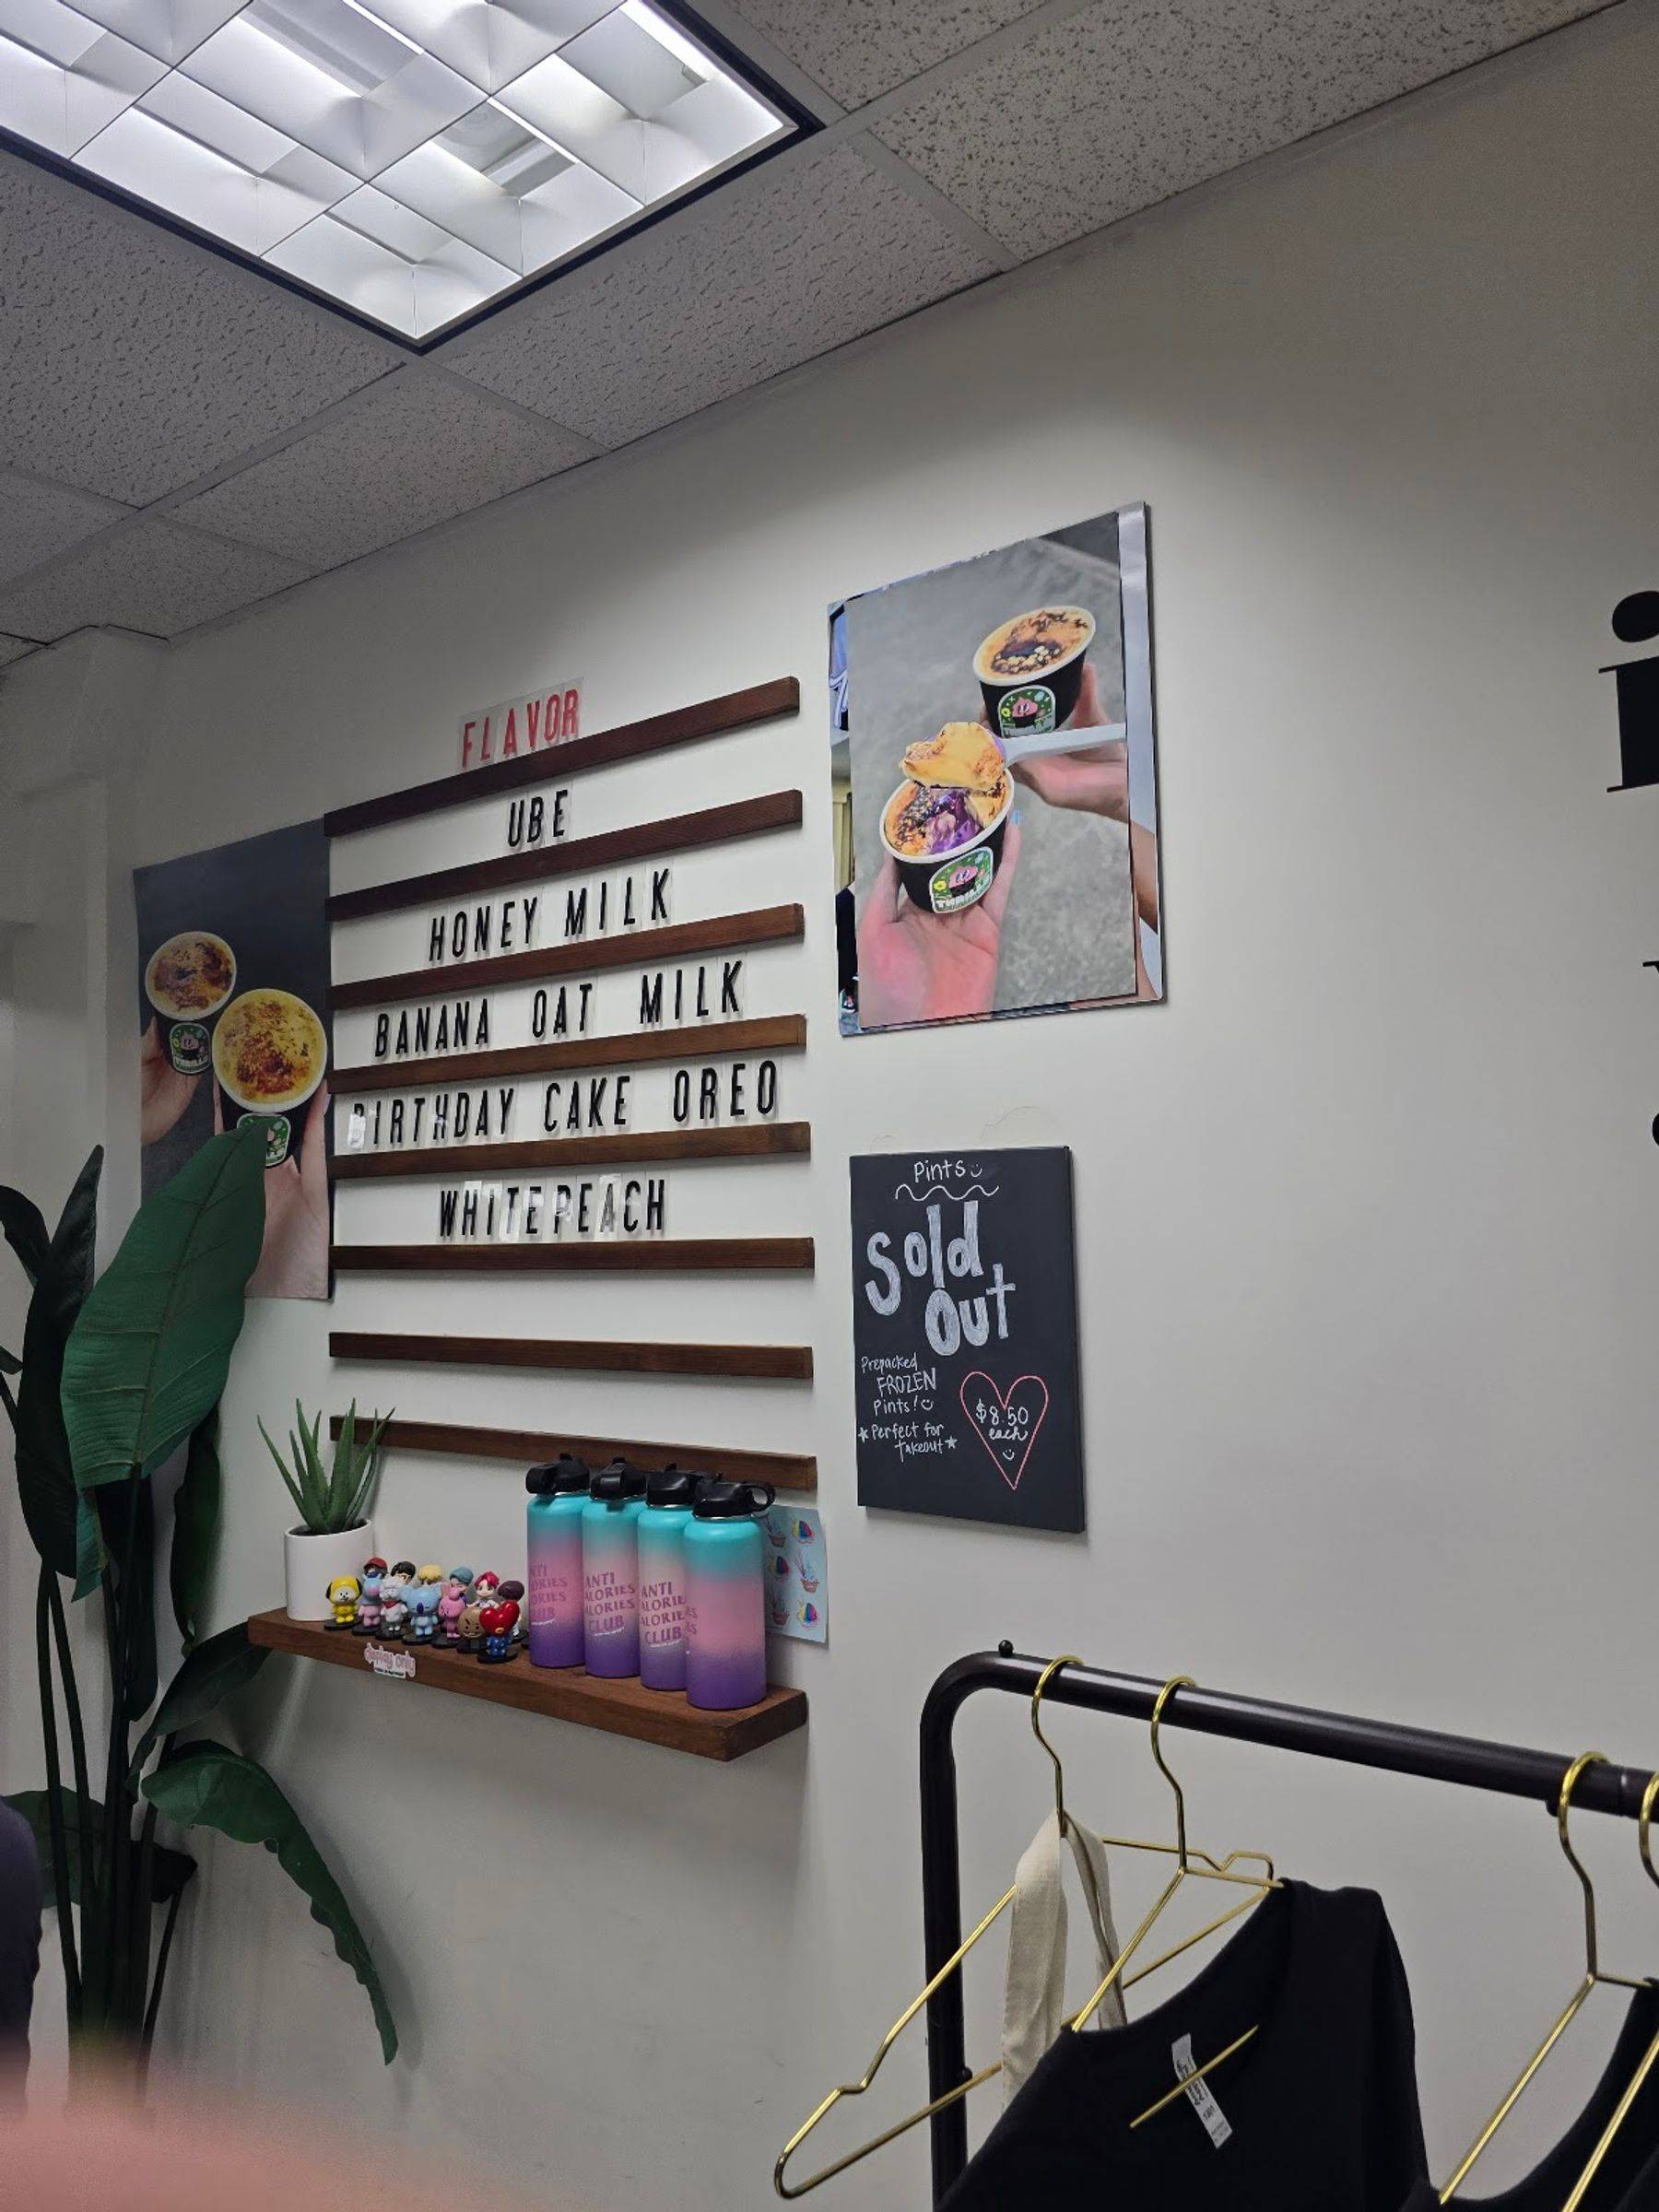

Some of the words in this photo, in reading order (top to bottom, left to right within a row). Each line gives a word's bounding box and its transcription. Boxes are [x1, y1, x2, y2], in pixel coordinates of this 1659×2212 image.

[463, 688, 580, 768] FLAVOR
[508, 789, 570, 847] UBE
[429, 897, 538, 962] HONEY
[565, 868, 671, 937] MILK
[374, 998, 490, 1058] BANANA
[531, 982, 593, 1039] OAT
[640, 960, 744, 1025] MILK
[544, 1075, 631, 1133] CAKE
[672, 1059, 778, 1124] OREO
[865, 1200, 984, 1316] Sold
[924, 1263, 1016, 1356] Out
[877, 1367, 936, 1397] FROZEN
[975, 1398, 1029, 1426] $8.50
[924, 1421, 944, 1438] for
[988, 1426, 1029, 1441] each
[531, 1577, 568, 1592] ORIES
[531, 1591, 568, 1606] ORIES
[584, 1583, 636, 1602] ALORIES
[584, 1598, 636, 1616] ALORIES
[645, 1626, 683, 1645] CLUB
